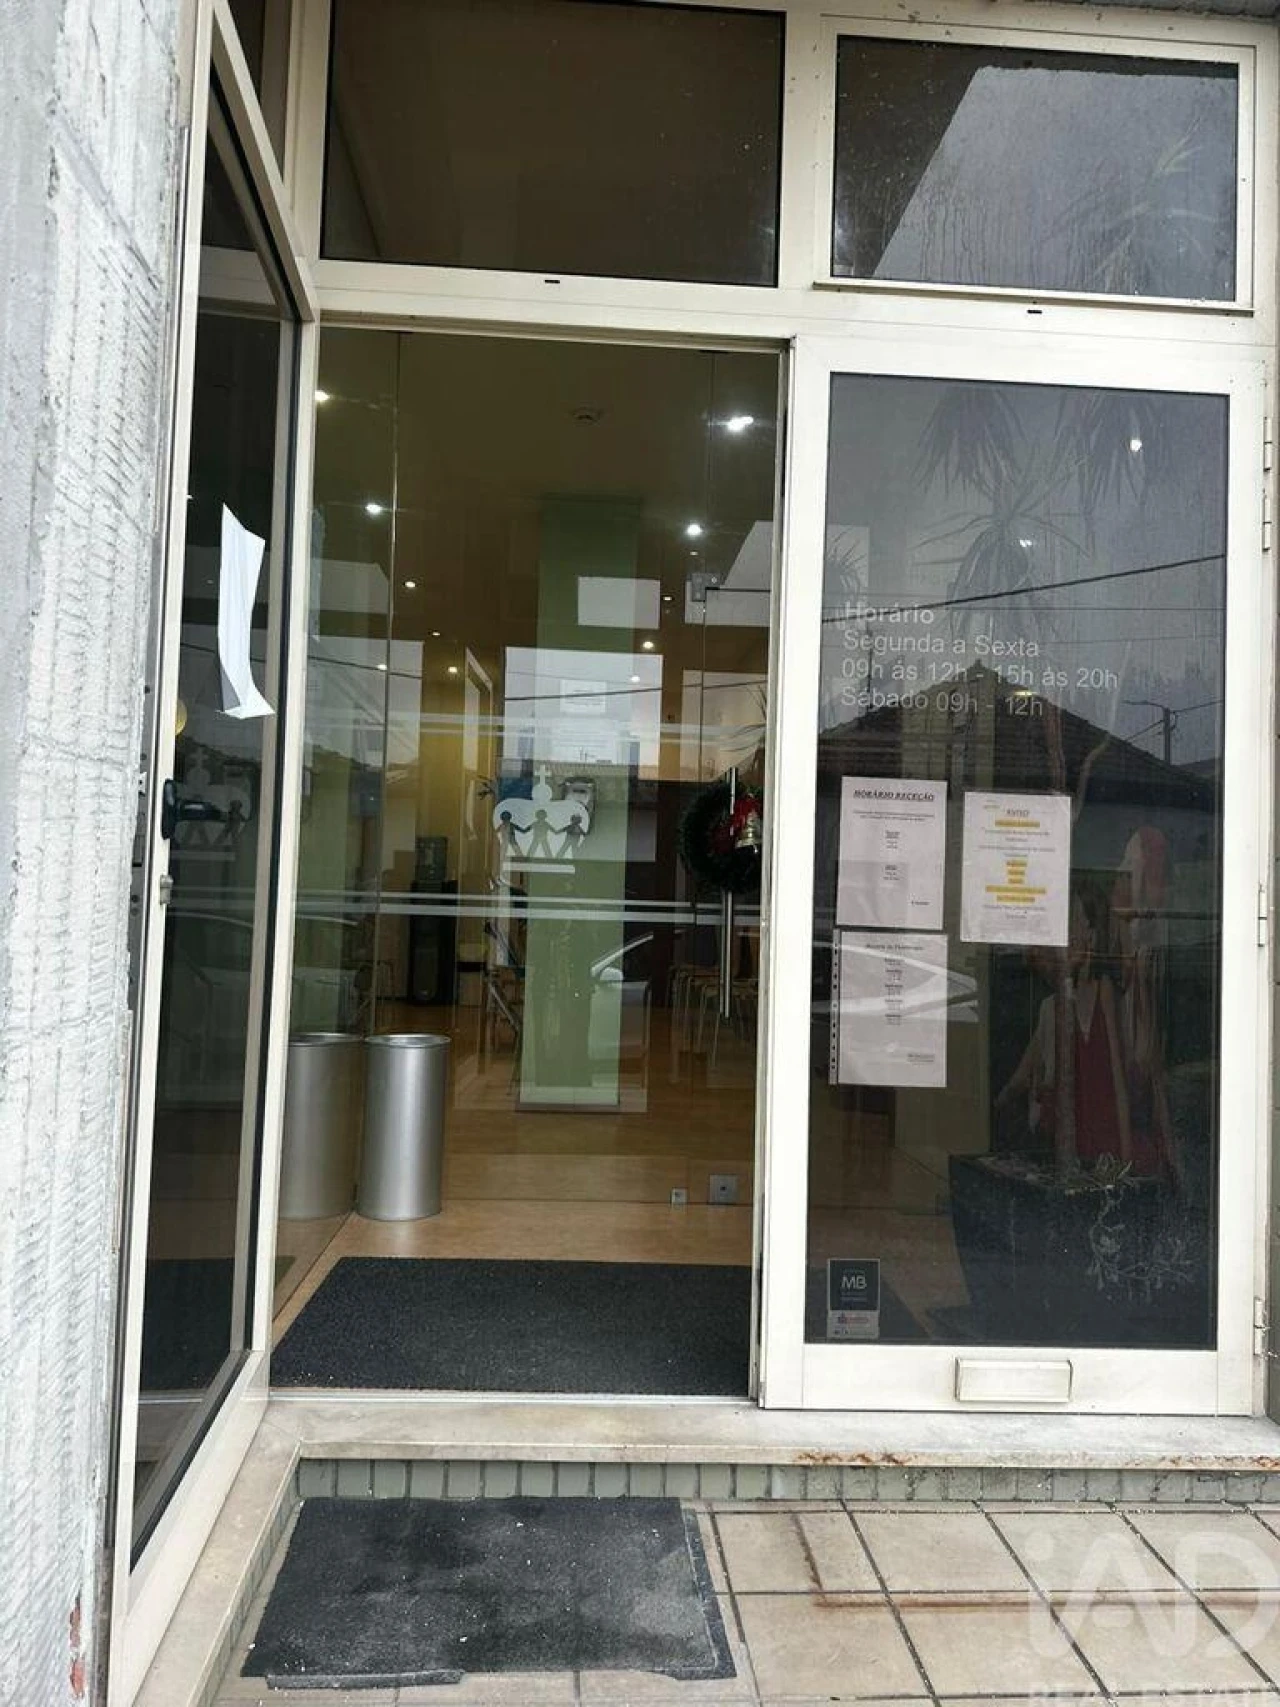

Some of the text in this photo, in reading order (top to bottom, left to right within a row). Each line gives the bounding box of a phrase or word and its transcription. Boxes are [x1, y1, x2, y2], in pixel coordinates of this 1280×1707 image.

[845, 602, 934, 624] Horário
[842, 629, 1040, 658] Segunda a Sexta
[841, 658, 883, 680] 09h
[929, 661, 968, 682] 12h
[996, 664, 1034, 686] 15h
[1075, 668, 1119, 690] 20h
[840, 686, 929, 710] Sábado
[936, 692, 978, 713] 09h
[1004, 695, 1043, 717] 12h
[841, 1275, 868, 1290] MB
